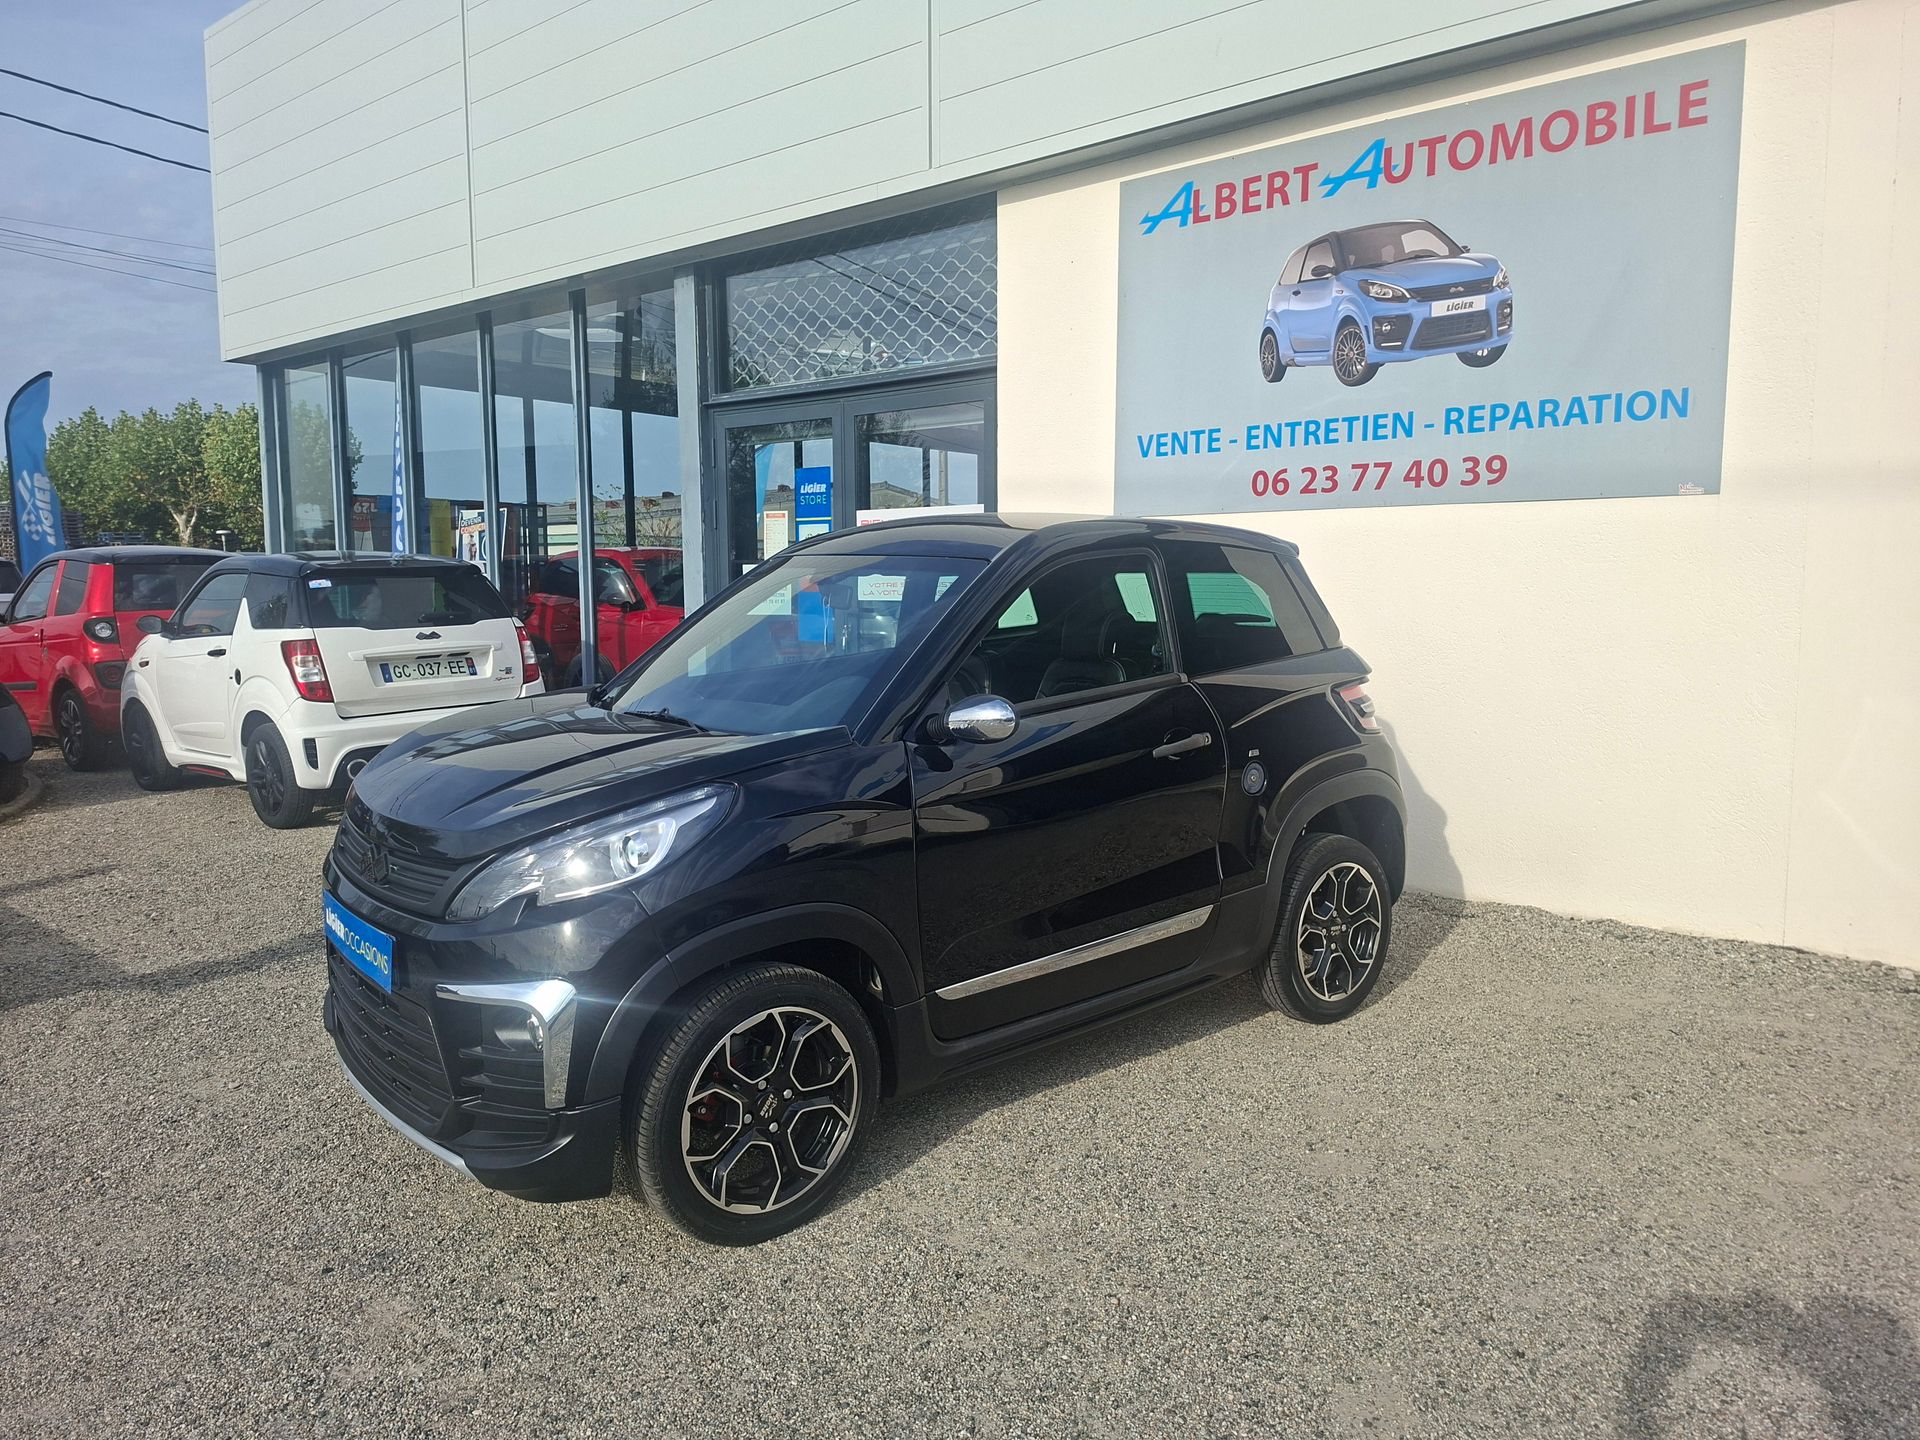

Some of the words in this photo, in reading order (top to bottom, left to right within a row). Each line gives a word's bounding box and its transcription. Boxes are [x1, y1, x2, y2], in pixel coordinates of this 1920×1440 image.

[1140, 163, 1318, 236] ALBERT
[1318, 80, 1709, 199] AUTOMOBILE
[1137, 428, 1222, 459] VENTE
[1245, 411, 1415, 451] ENTRETIEN
[1443, 388, 1690, 436] REPARATION
[1252, 469, 1290, 497] 06
[1301, 466, 1338, 495] 23
[1350, 462, 1393, 492] 77
[1402, 459, 1448, 489] 40
[1461, 456, 1508, 487] 39
[800, 494, 827, 506] STORE
[863, 589, 875, 597] LA
[868, 581, 898, 589] VOTRE
[344, 927, 389, 975] OCCASIONS
